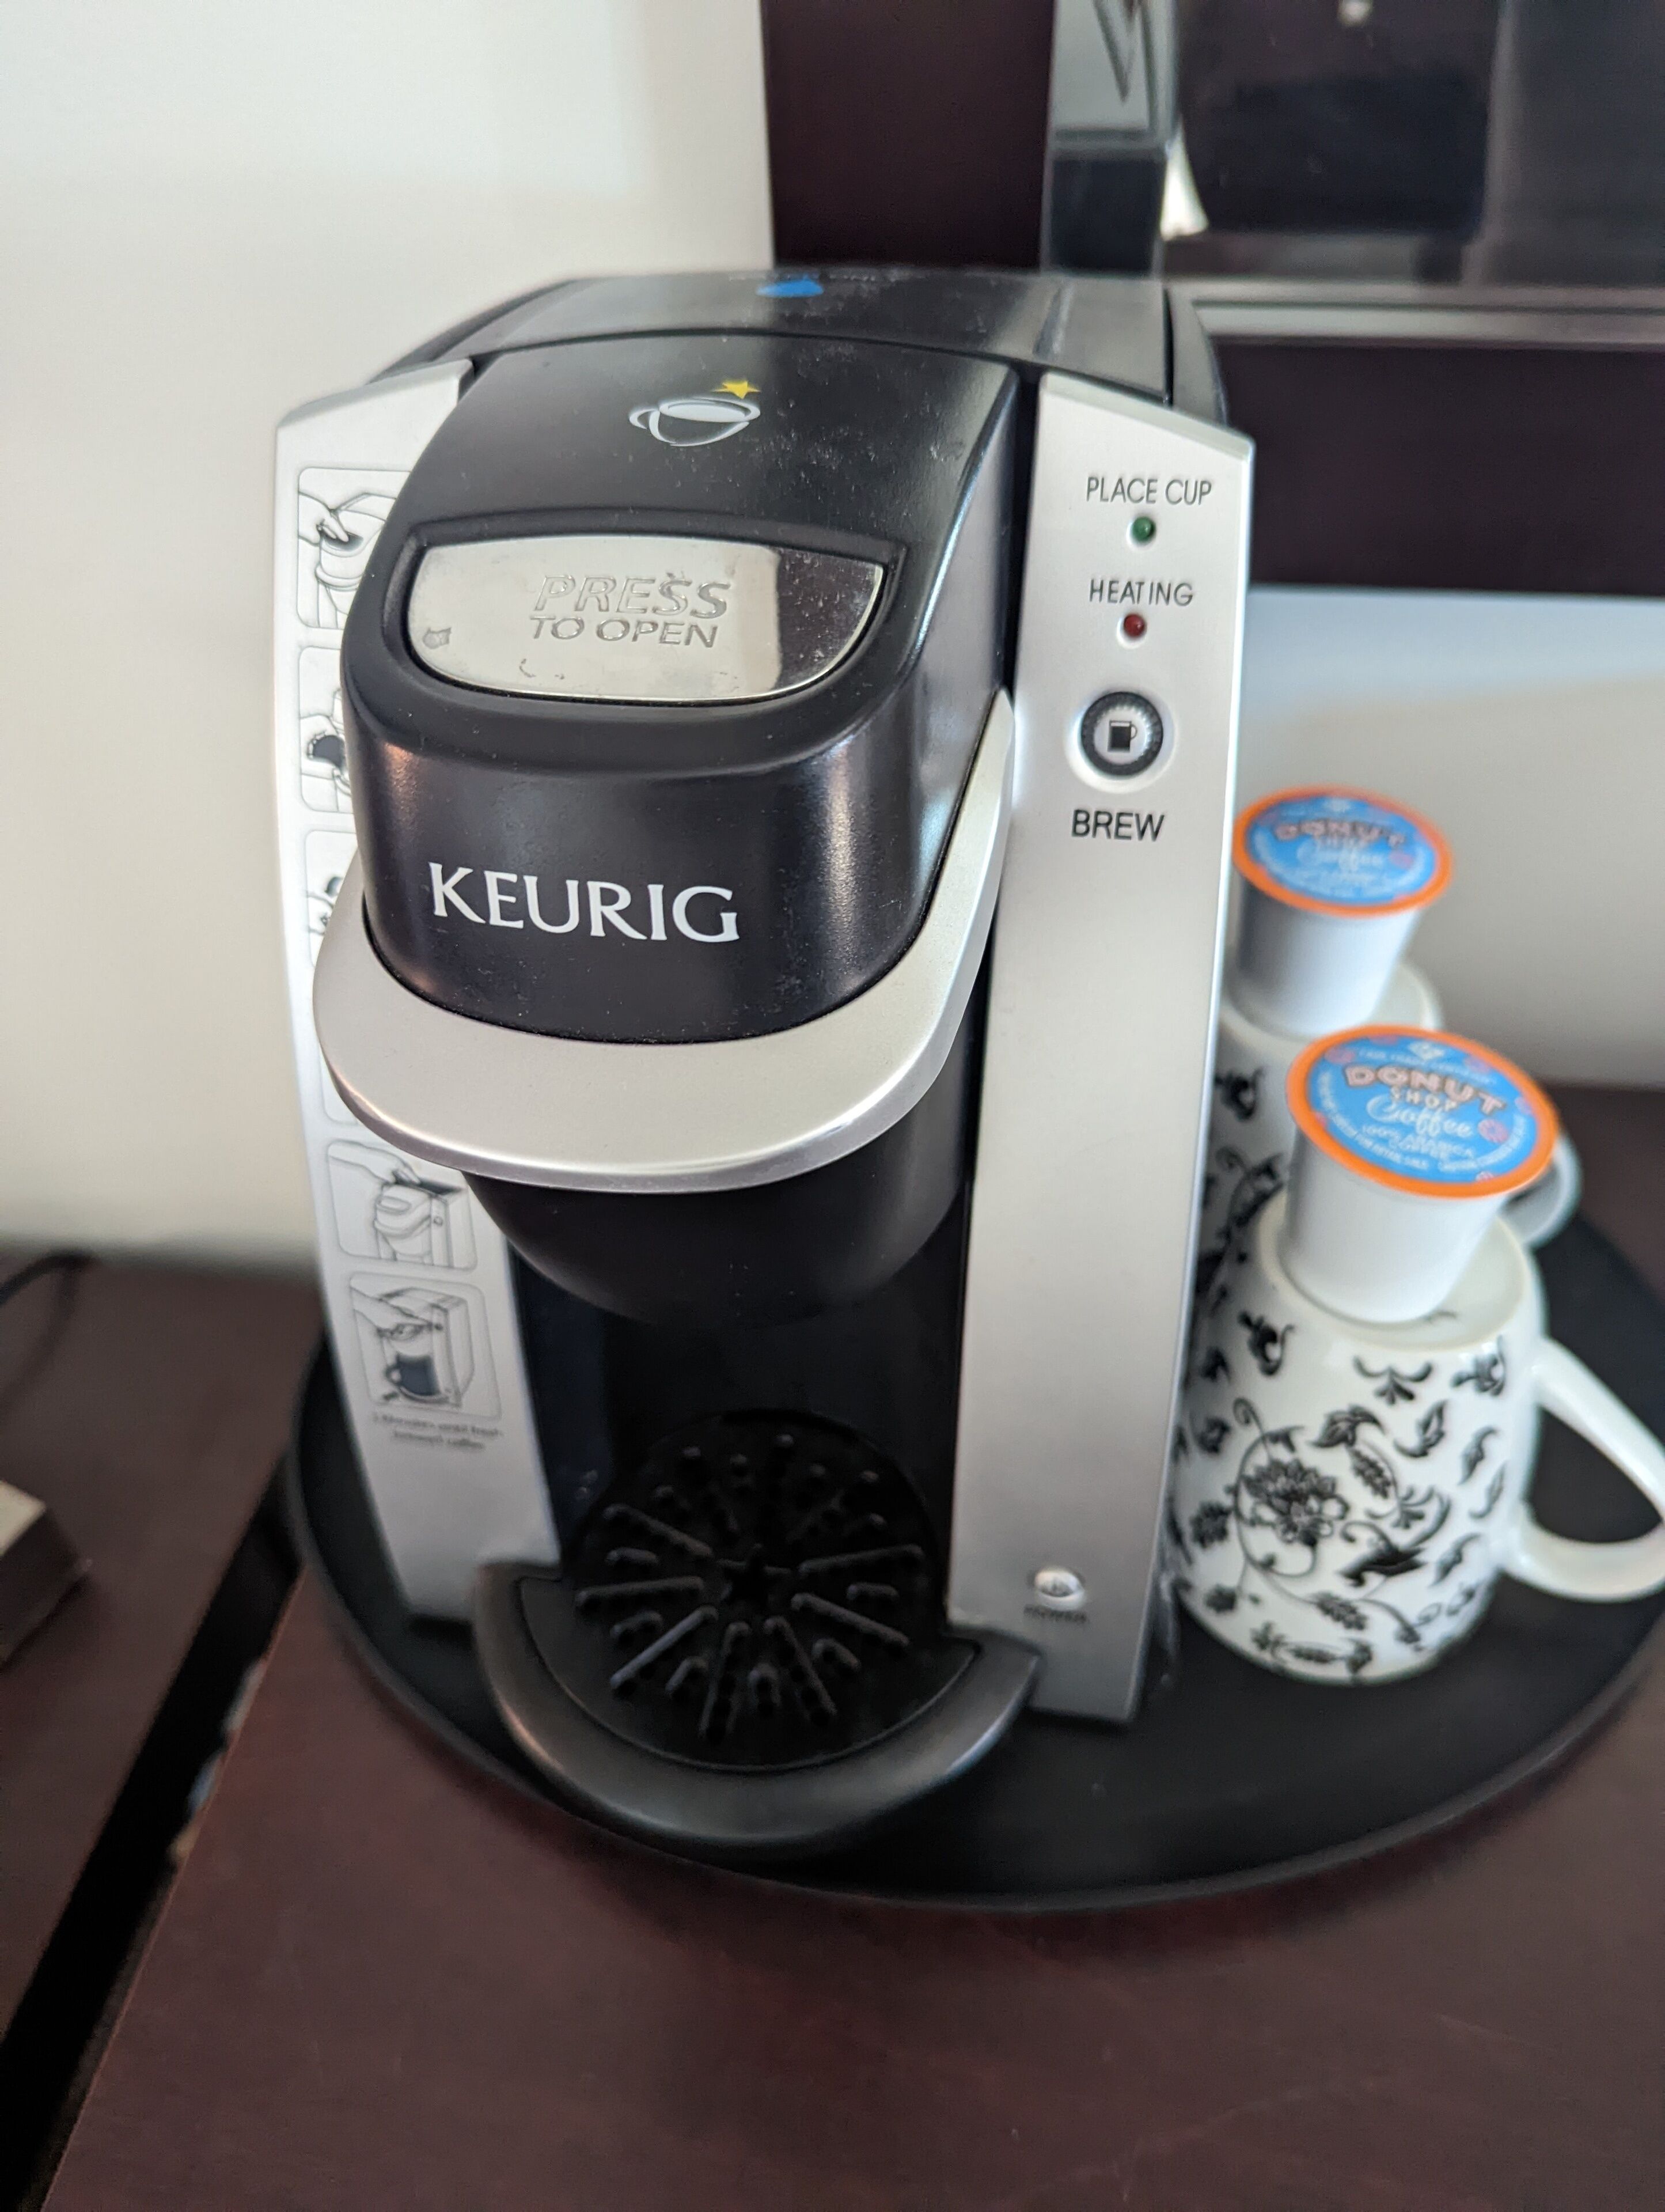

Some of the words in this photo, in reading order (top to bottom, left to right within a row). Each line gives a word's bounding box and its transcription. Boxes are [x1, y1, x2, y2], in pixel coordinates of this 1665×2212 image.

[1087, 476, 1158, 504] PLACE
[1165, 479, 1212, 505] CUP
[533, 574, 731, 619] PRESS
[1089, 579, 1194, 607] HEATING
[531, 616, 583, 641] TO
[596, 617, 719, 649] OPEN
[1071, 809, 1165, 842] BREW
[428, 862, 740, 943] KEURIG
[1343, 1065, 1507, 1116] DONUT
[1389, 1085, 1459, 1112] SHOP
[1366, 1094, 1473, 1137] Coffee
